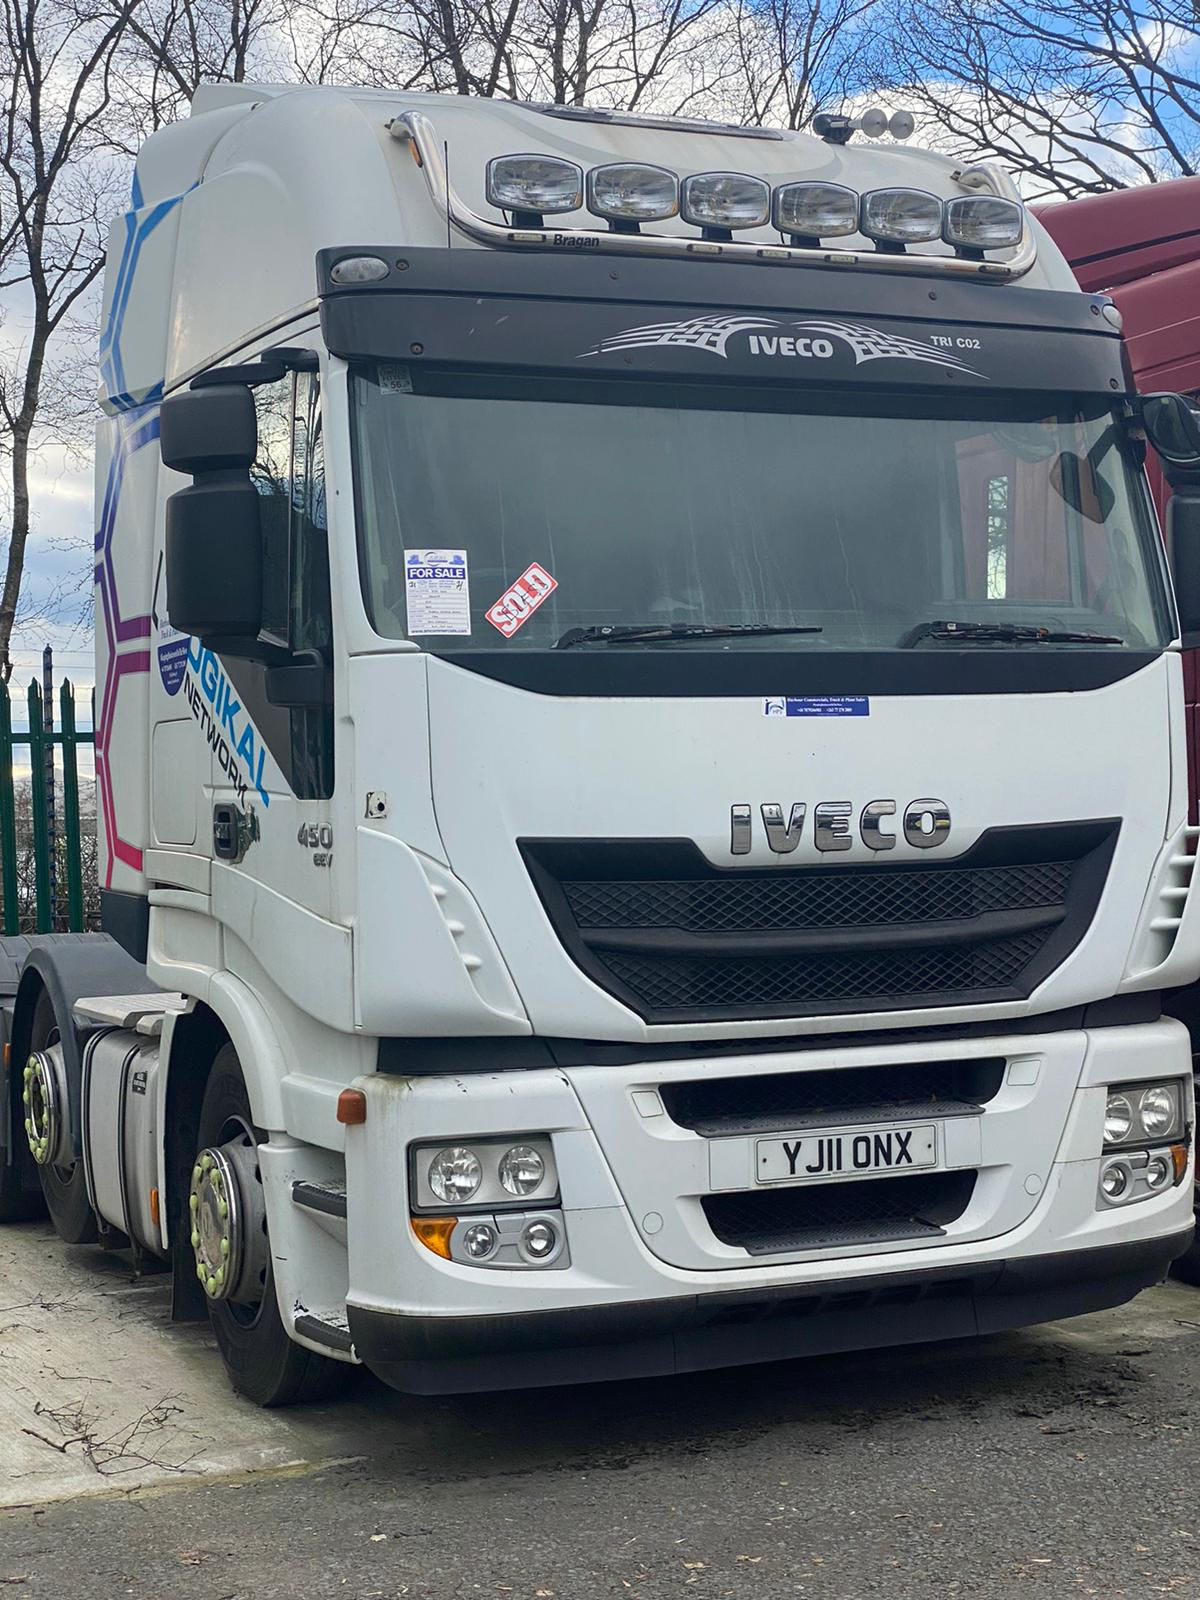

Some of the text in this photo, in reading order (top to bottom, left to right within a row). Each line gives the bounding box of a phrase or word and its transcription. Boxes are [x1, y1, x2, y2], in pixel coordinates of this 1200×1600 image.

[553, 234, 600, 248] Bragan
[749, 335, 833, 358] IVECO
[930, 336, 953, 347] TRI
[410, 568, 464, 578] FOR SALE
[490, 567, 553, 632] SOLD
[183, 671, 248, 808] NETWORK
[297, 822, 333, 849] 450
[731, 798, 951, 855] IVECO
[783, 1131, 912, 1175] YJ11 ONX
